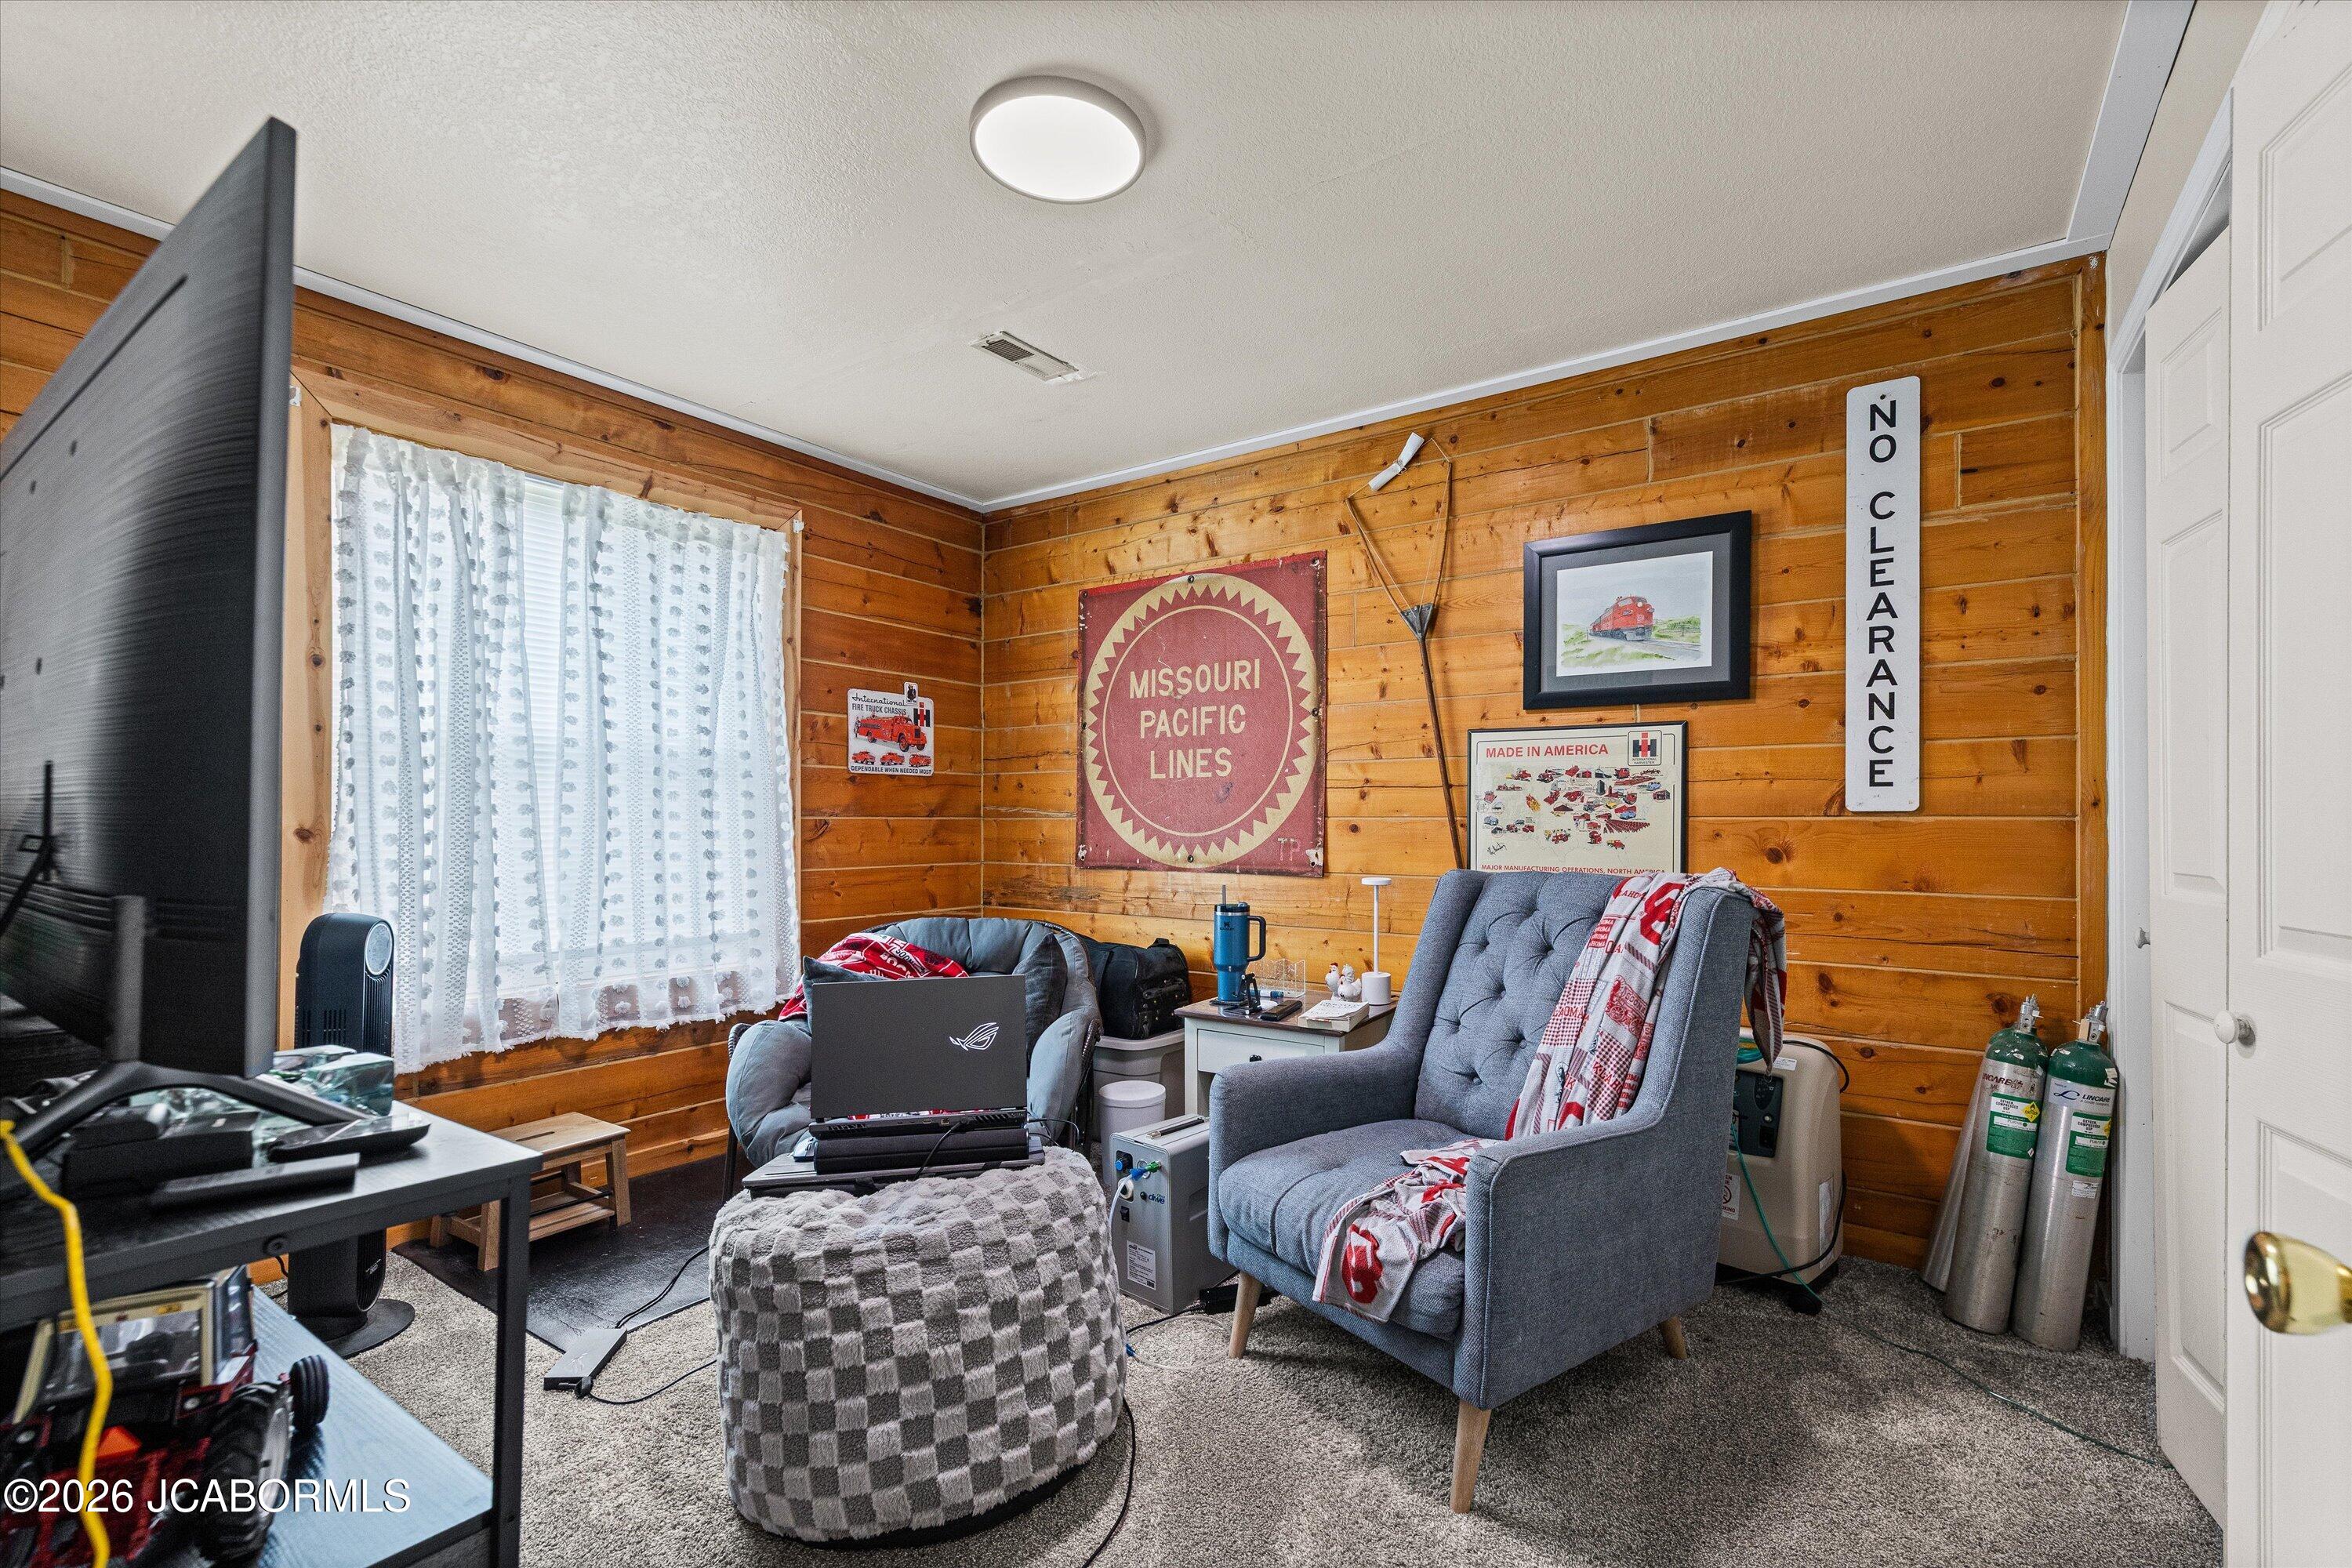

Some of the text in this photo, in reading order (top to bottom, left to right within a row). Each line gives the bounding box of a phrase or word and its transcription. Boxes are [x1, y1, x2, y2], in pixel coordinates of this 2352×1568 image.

[1865, 399, 1898, 788] NO CLEARANCE
[1129, 658, 1261, 699] MISSOURI
[851, 693, 906, 707] International
[866, 705, 884, 713] TRUCK
[884, 706, 907, 715] CHASSIS
[1139, 703, 1247, 739] PACIFIC
[1486, 743, 1609, 758] MADE IN AMERICA
[1149, 747, 1233, 780] LINES
[2082, 1094, 2111, 1102] LINCARE
[1148, 1193, 1165, 1205] drive
